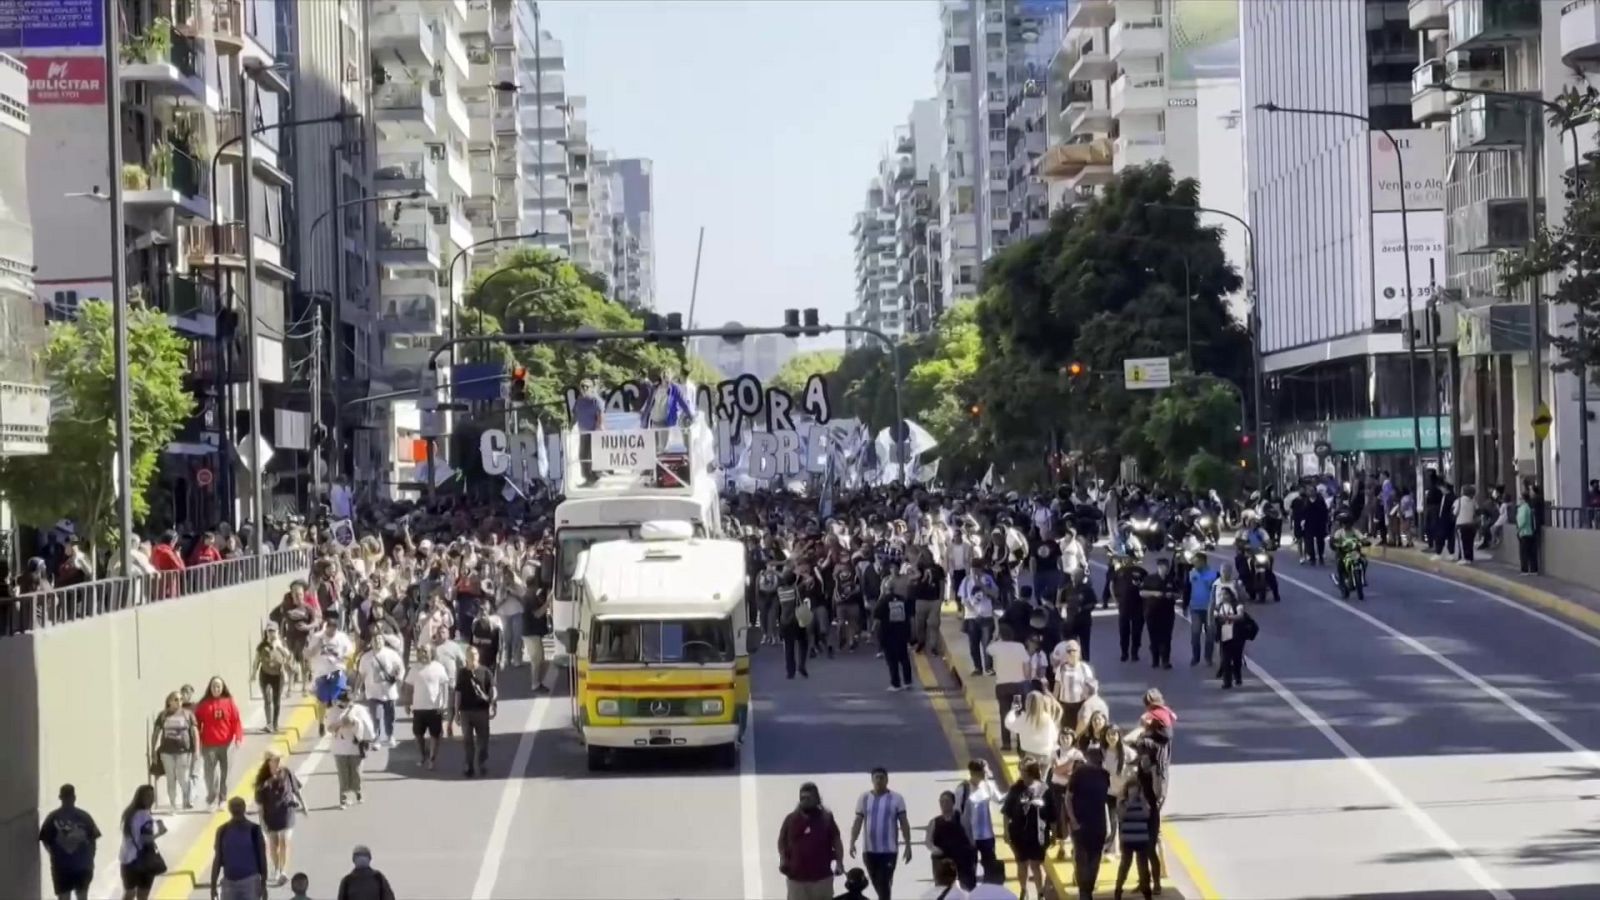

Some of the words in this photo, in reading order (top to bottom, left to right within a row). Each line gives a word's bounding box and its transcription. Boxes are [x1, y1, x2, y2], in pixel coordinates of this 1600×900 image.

[28, 79, 100, 90] UBLICITAR
[1378, 180, 1412, 191] Vena
[601, 434, 645, 449] NUNCA
